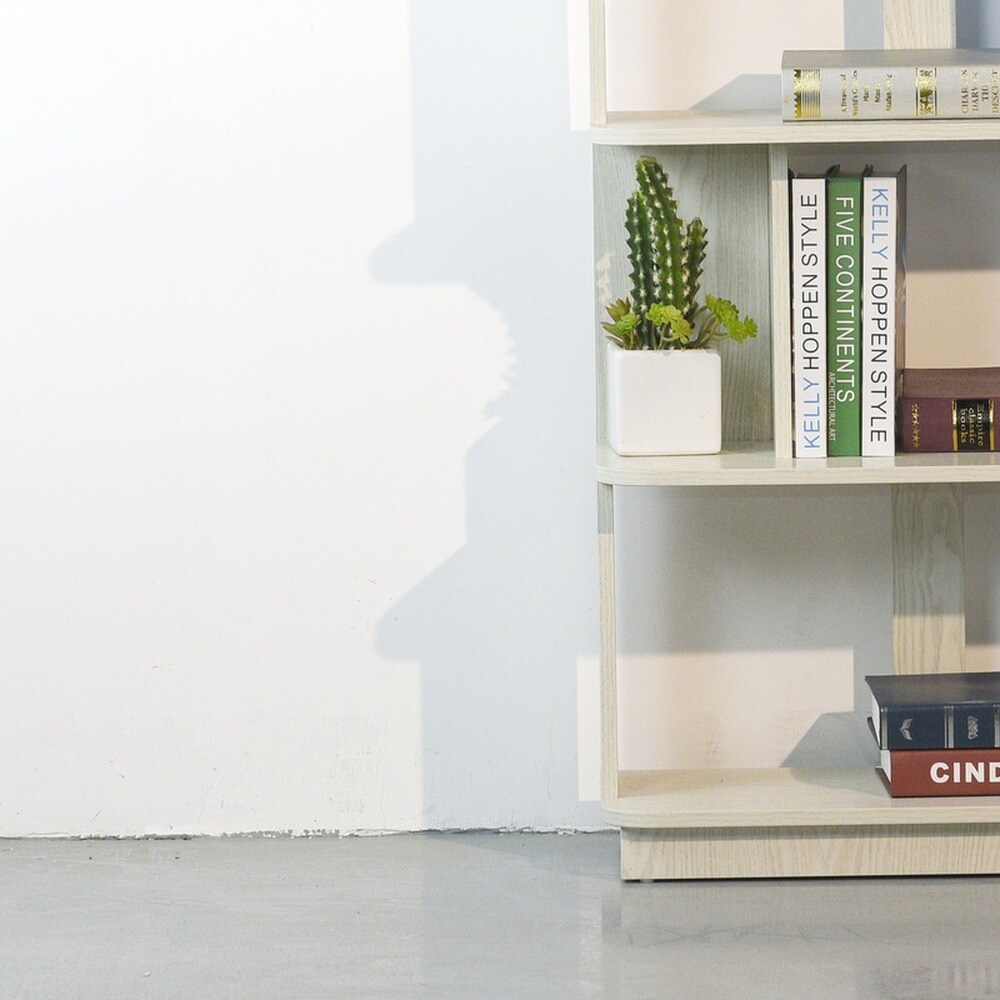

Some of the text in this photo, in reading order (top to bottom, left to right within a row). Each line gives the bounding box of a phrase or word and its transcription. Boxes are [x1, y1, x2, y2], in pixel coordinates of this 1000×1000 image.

[801, 194, 821, 449] KELLY HOPPEN STYLE
[835, 197, 855, 403] FIVE CONTINENTS
[870, 188, 889, 443] KELLY HOPPEN STYLE
[828, 372, 836, 441] ARCHITECTURAL ART
[960, 407, 968, 443] books
[968, 407, 977, 444] classic
[976, 403, 985, 447] Empire
